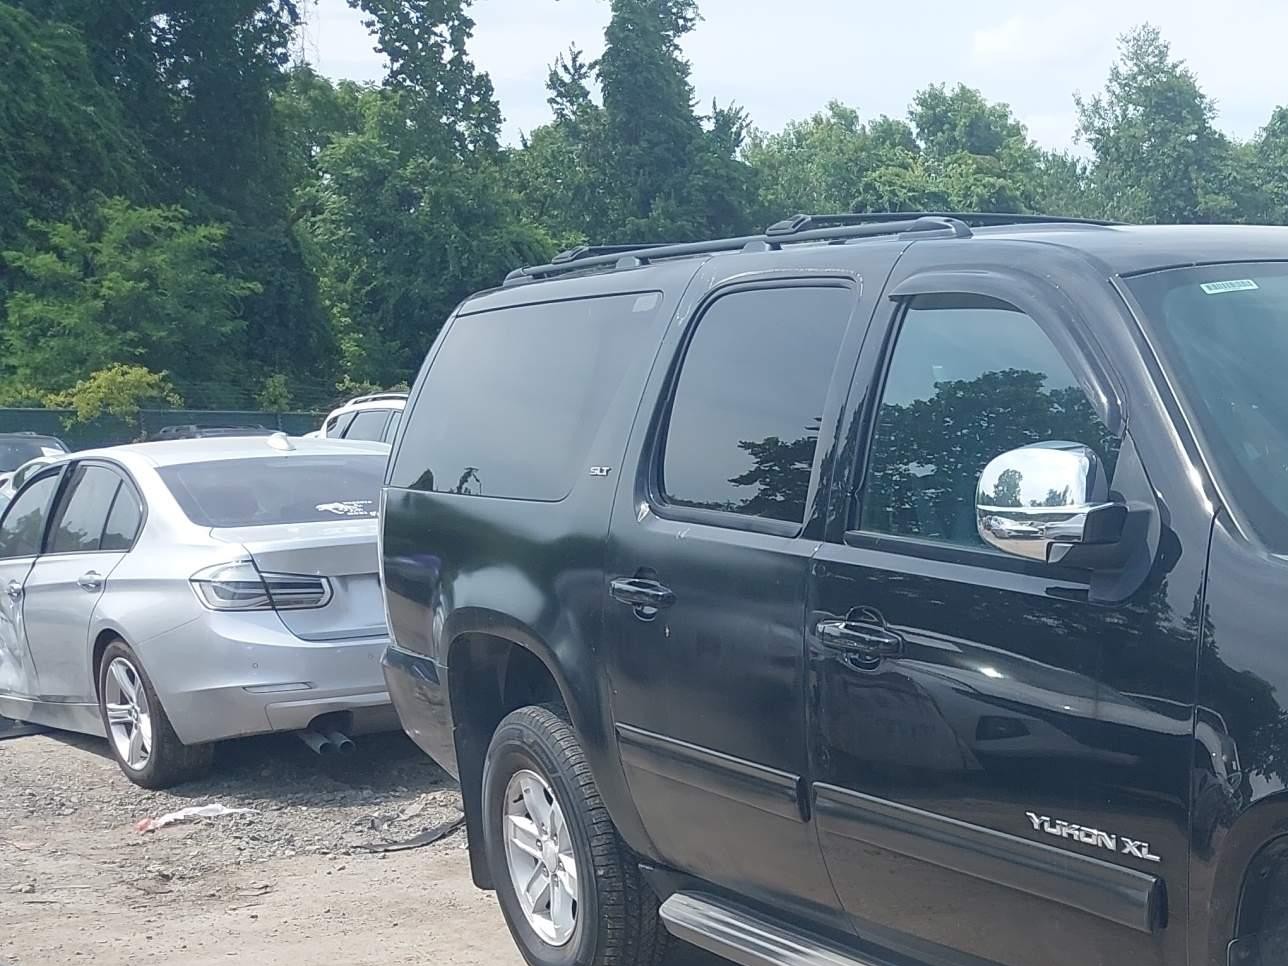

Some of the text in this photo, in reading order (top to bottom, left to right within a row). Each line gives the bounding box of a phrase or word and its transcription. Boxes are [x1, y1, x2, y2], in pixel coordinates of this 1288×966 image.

[588, 466, 611, 476] SLT
[1025, 811, 1160, 862] YUKON XL
